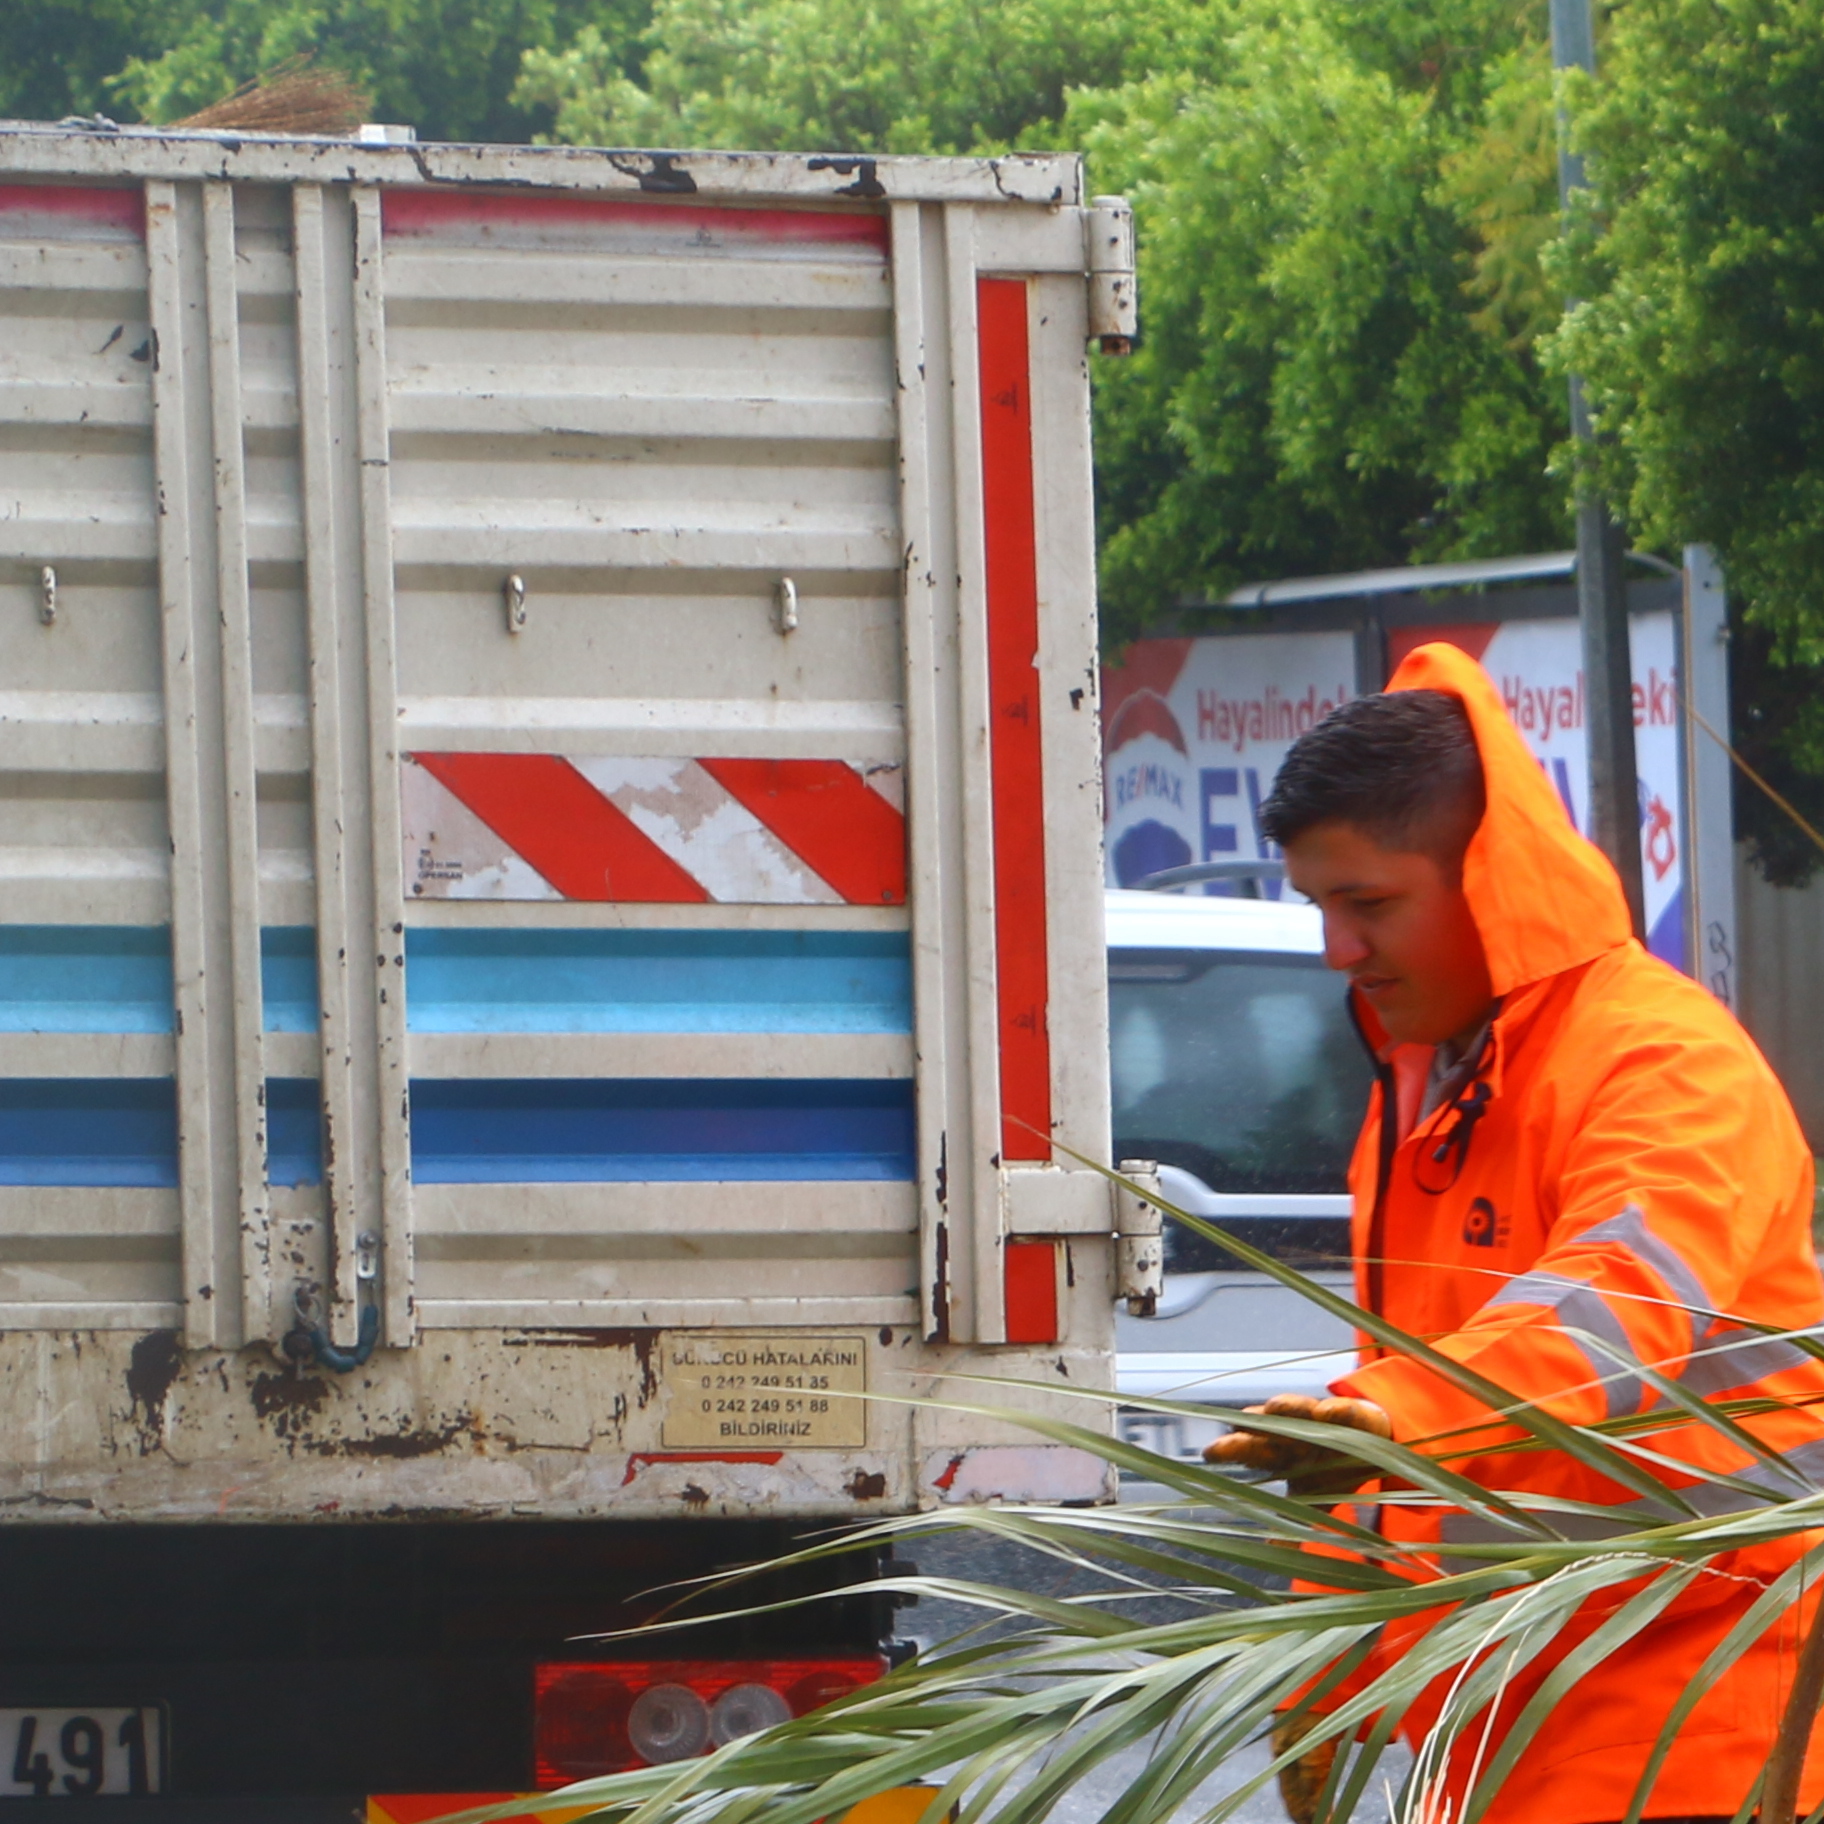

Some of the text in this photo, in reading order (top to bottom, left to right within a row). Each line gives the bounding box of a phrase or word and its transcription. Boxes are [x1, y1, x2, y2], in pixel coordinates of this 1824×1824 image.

[1115, 764, 1184, 810] RE/MAX
[752, 1349, 857, 1366] HATALARINI
[701, 1375, 710, 1389] 0
[785, 1376, 803, 1389] 51
[702, 1399, 711, 1412] 0
[716, 1399, 745, 1412] 242
[751, 1399, 779, 1412] 249
[809, 1399, 829, 1412] 88
[719, 1420, 811, 1436] BİLDİRİNİZ
